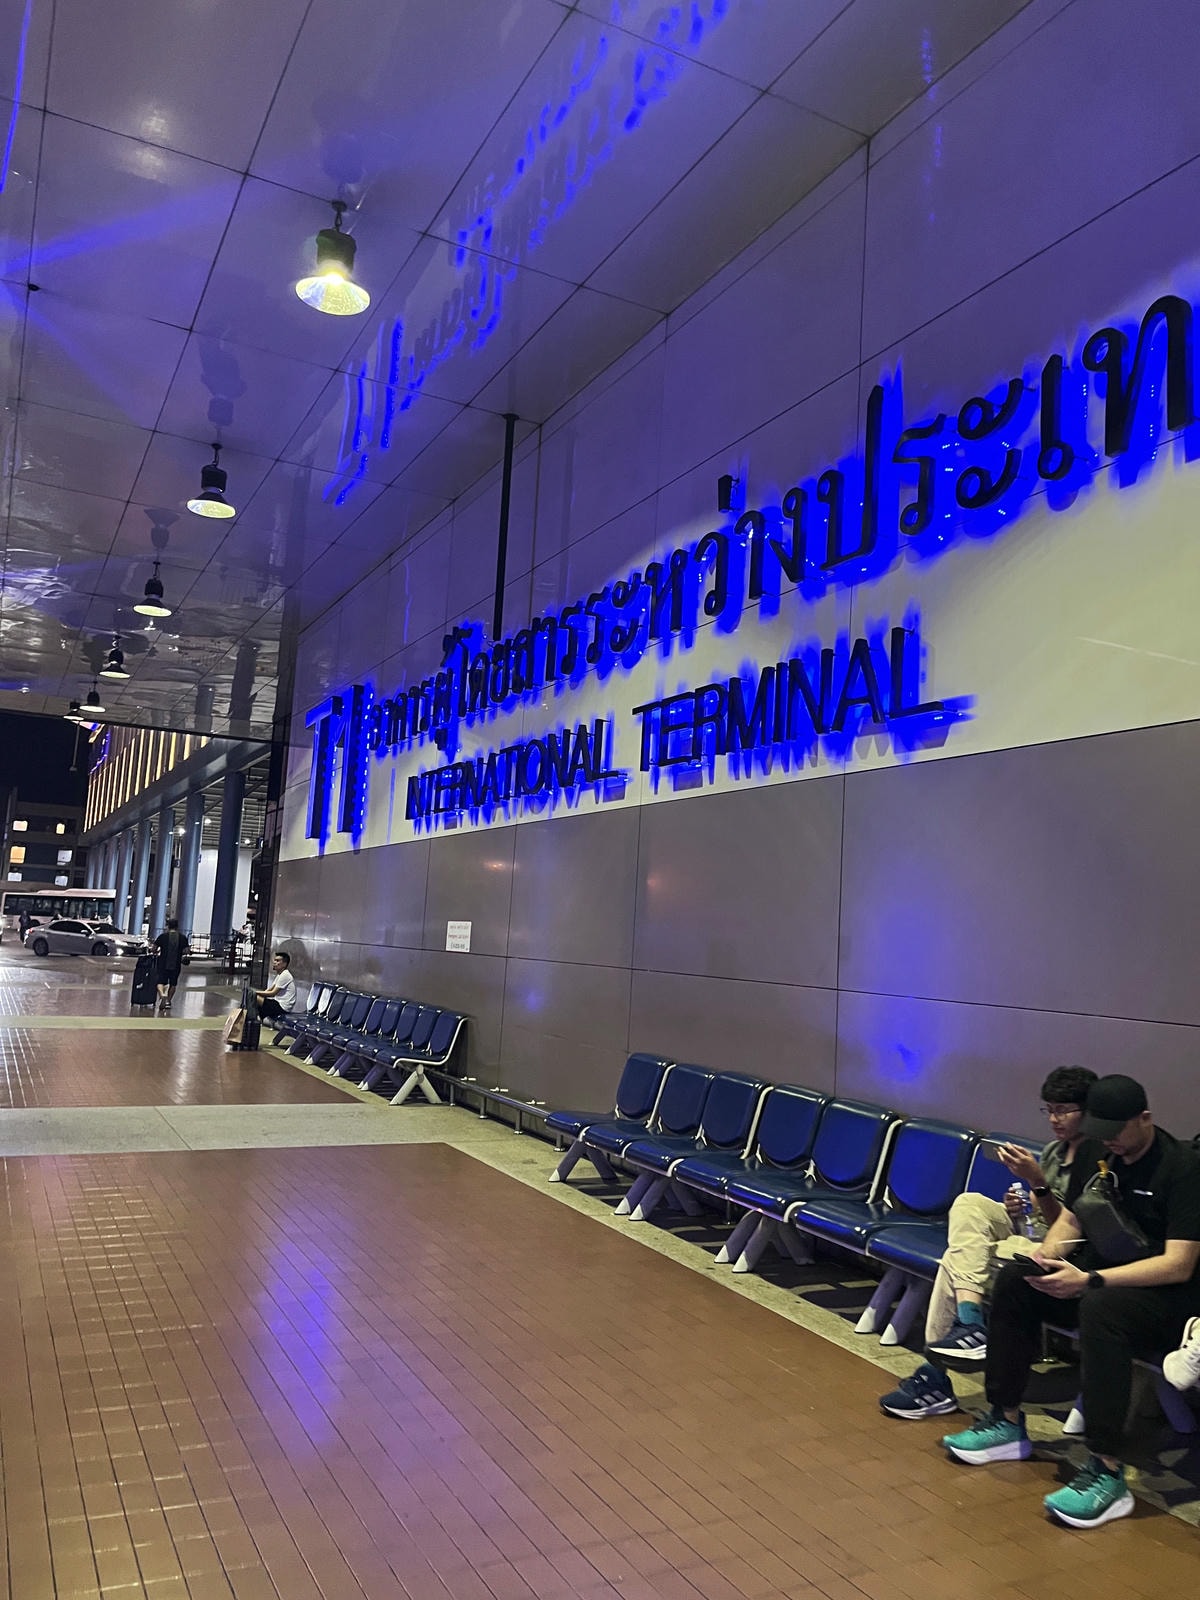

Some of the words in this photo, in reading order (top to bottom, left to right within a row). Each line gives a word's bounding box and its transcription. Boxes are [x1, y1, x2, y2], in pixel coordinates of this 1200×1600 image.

[305, 685, 364, 839] T1
[405, 718, 620, 820] INTERNATIONAL
[632, 627, 944, 772] TERMINAL
